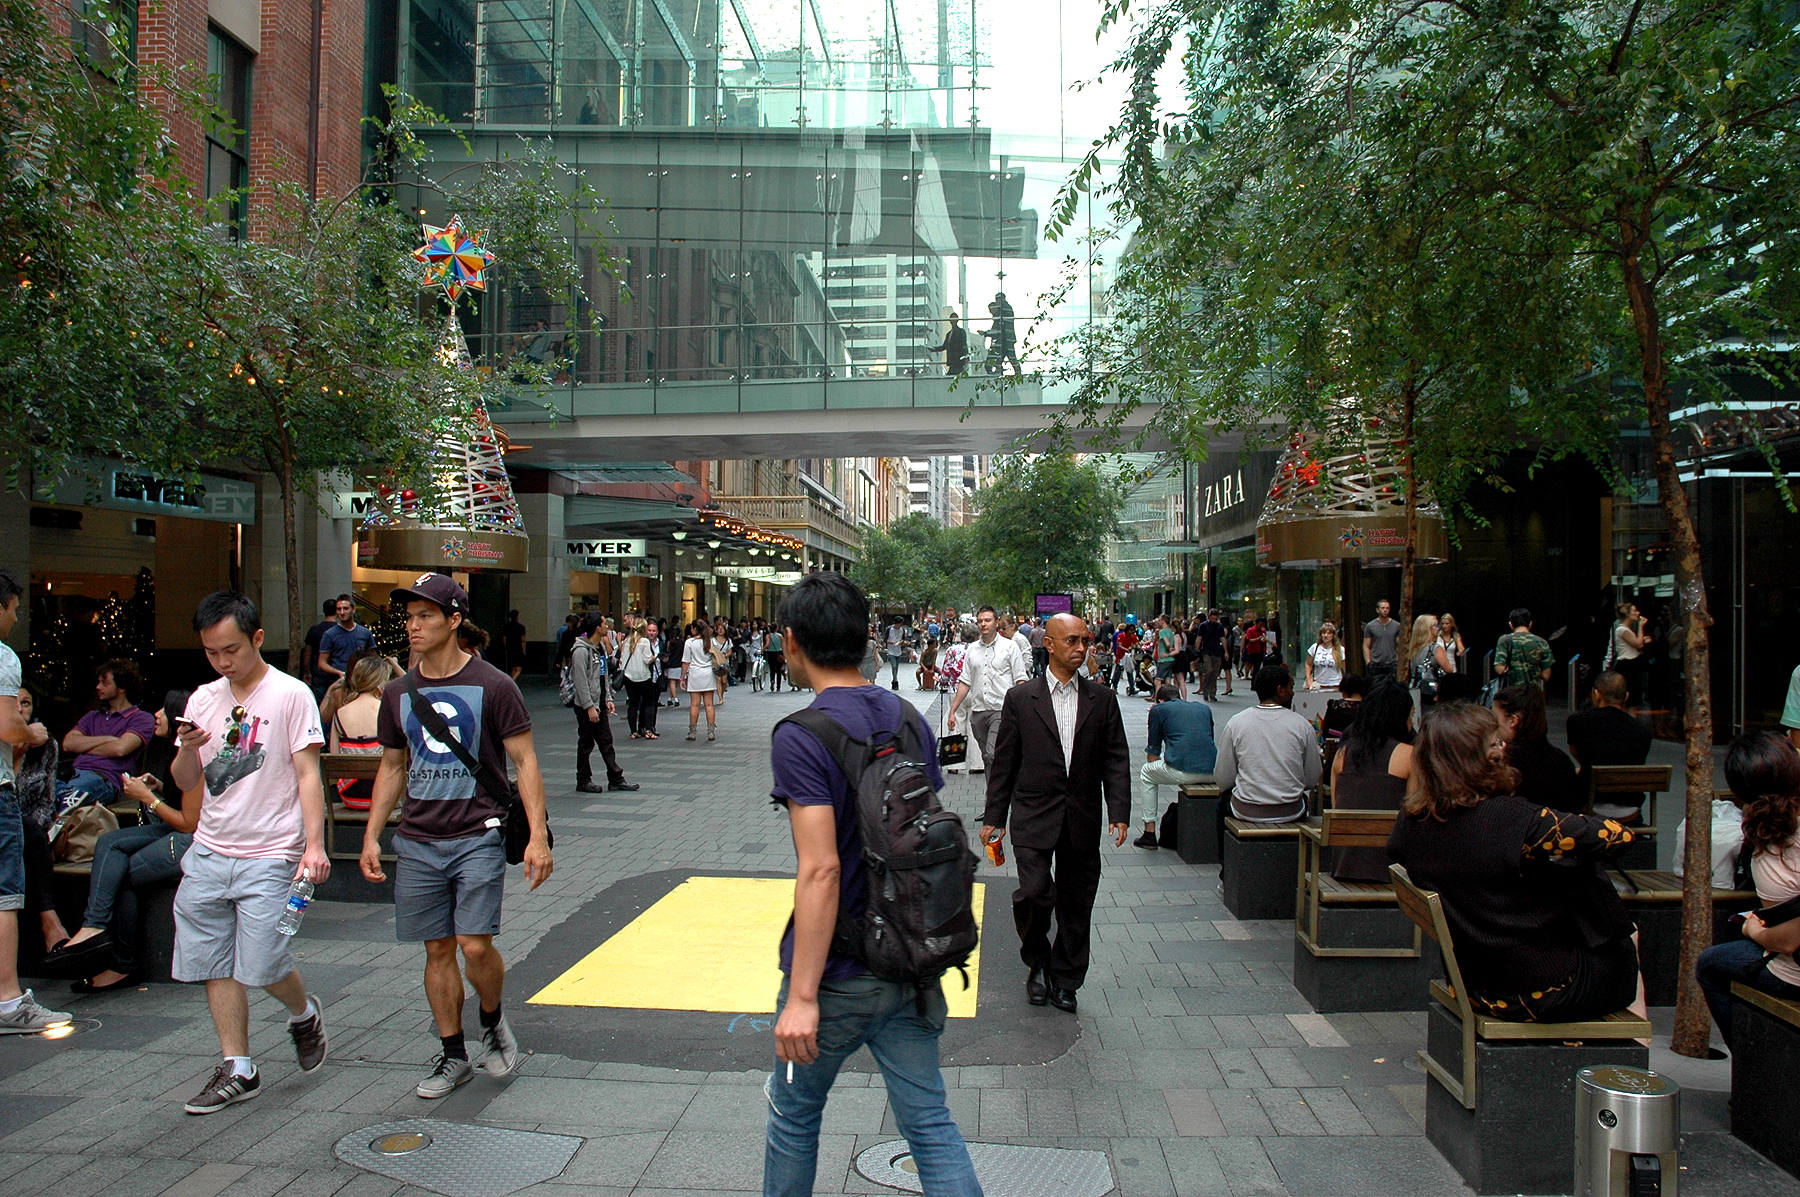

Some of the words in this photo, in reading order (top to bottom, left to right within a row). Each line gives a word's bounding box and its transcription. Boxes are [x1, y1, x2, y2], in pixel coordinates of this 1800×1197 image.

[1204, 469, 1245, 518] ZARA
[1367, 528, 1396, 536] HAPPY
[1367, 536, 1406, 545] CHRISTM
[467, 542, 491, 550] HAPPY
[566, 543, 632, 554] MYER
[467, 549, 504, 559] CHRISTMAS
[410, 769, 450, 780] G-STAR
[452, 767, 473, 779] RA
